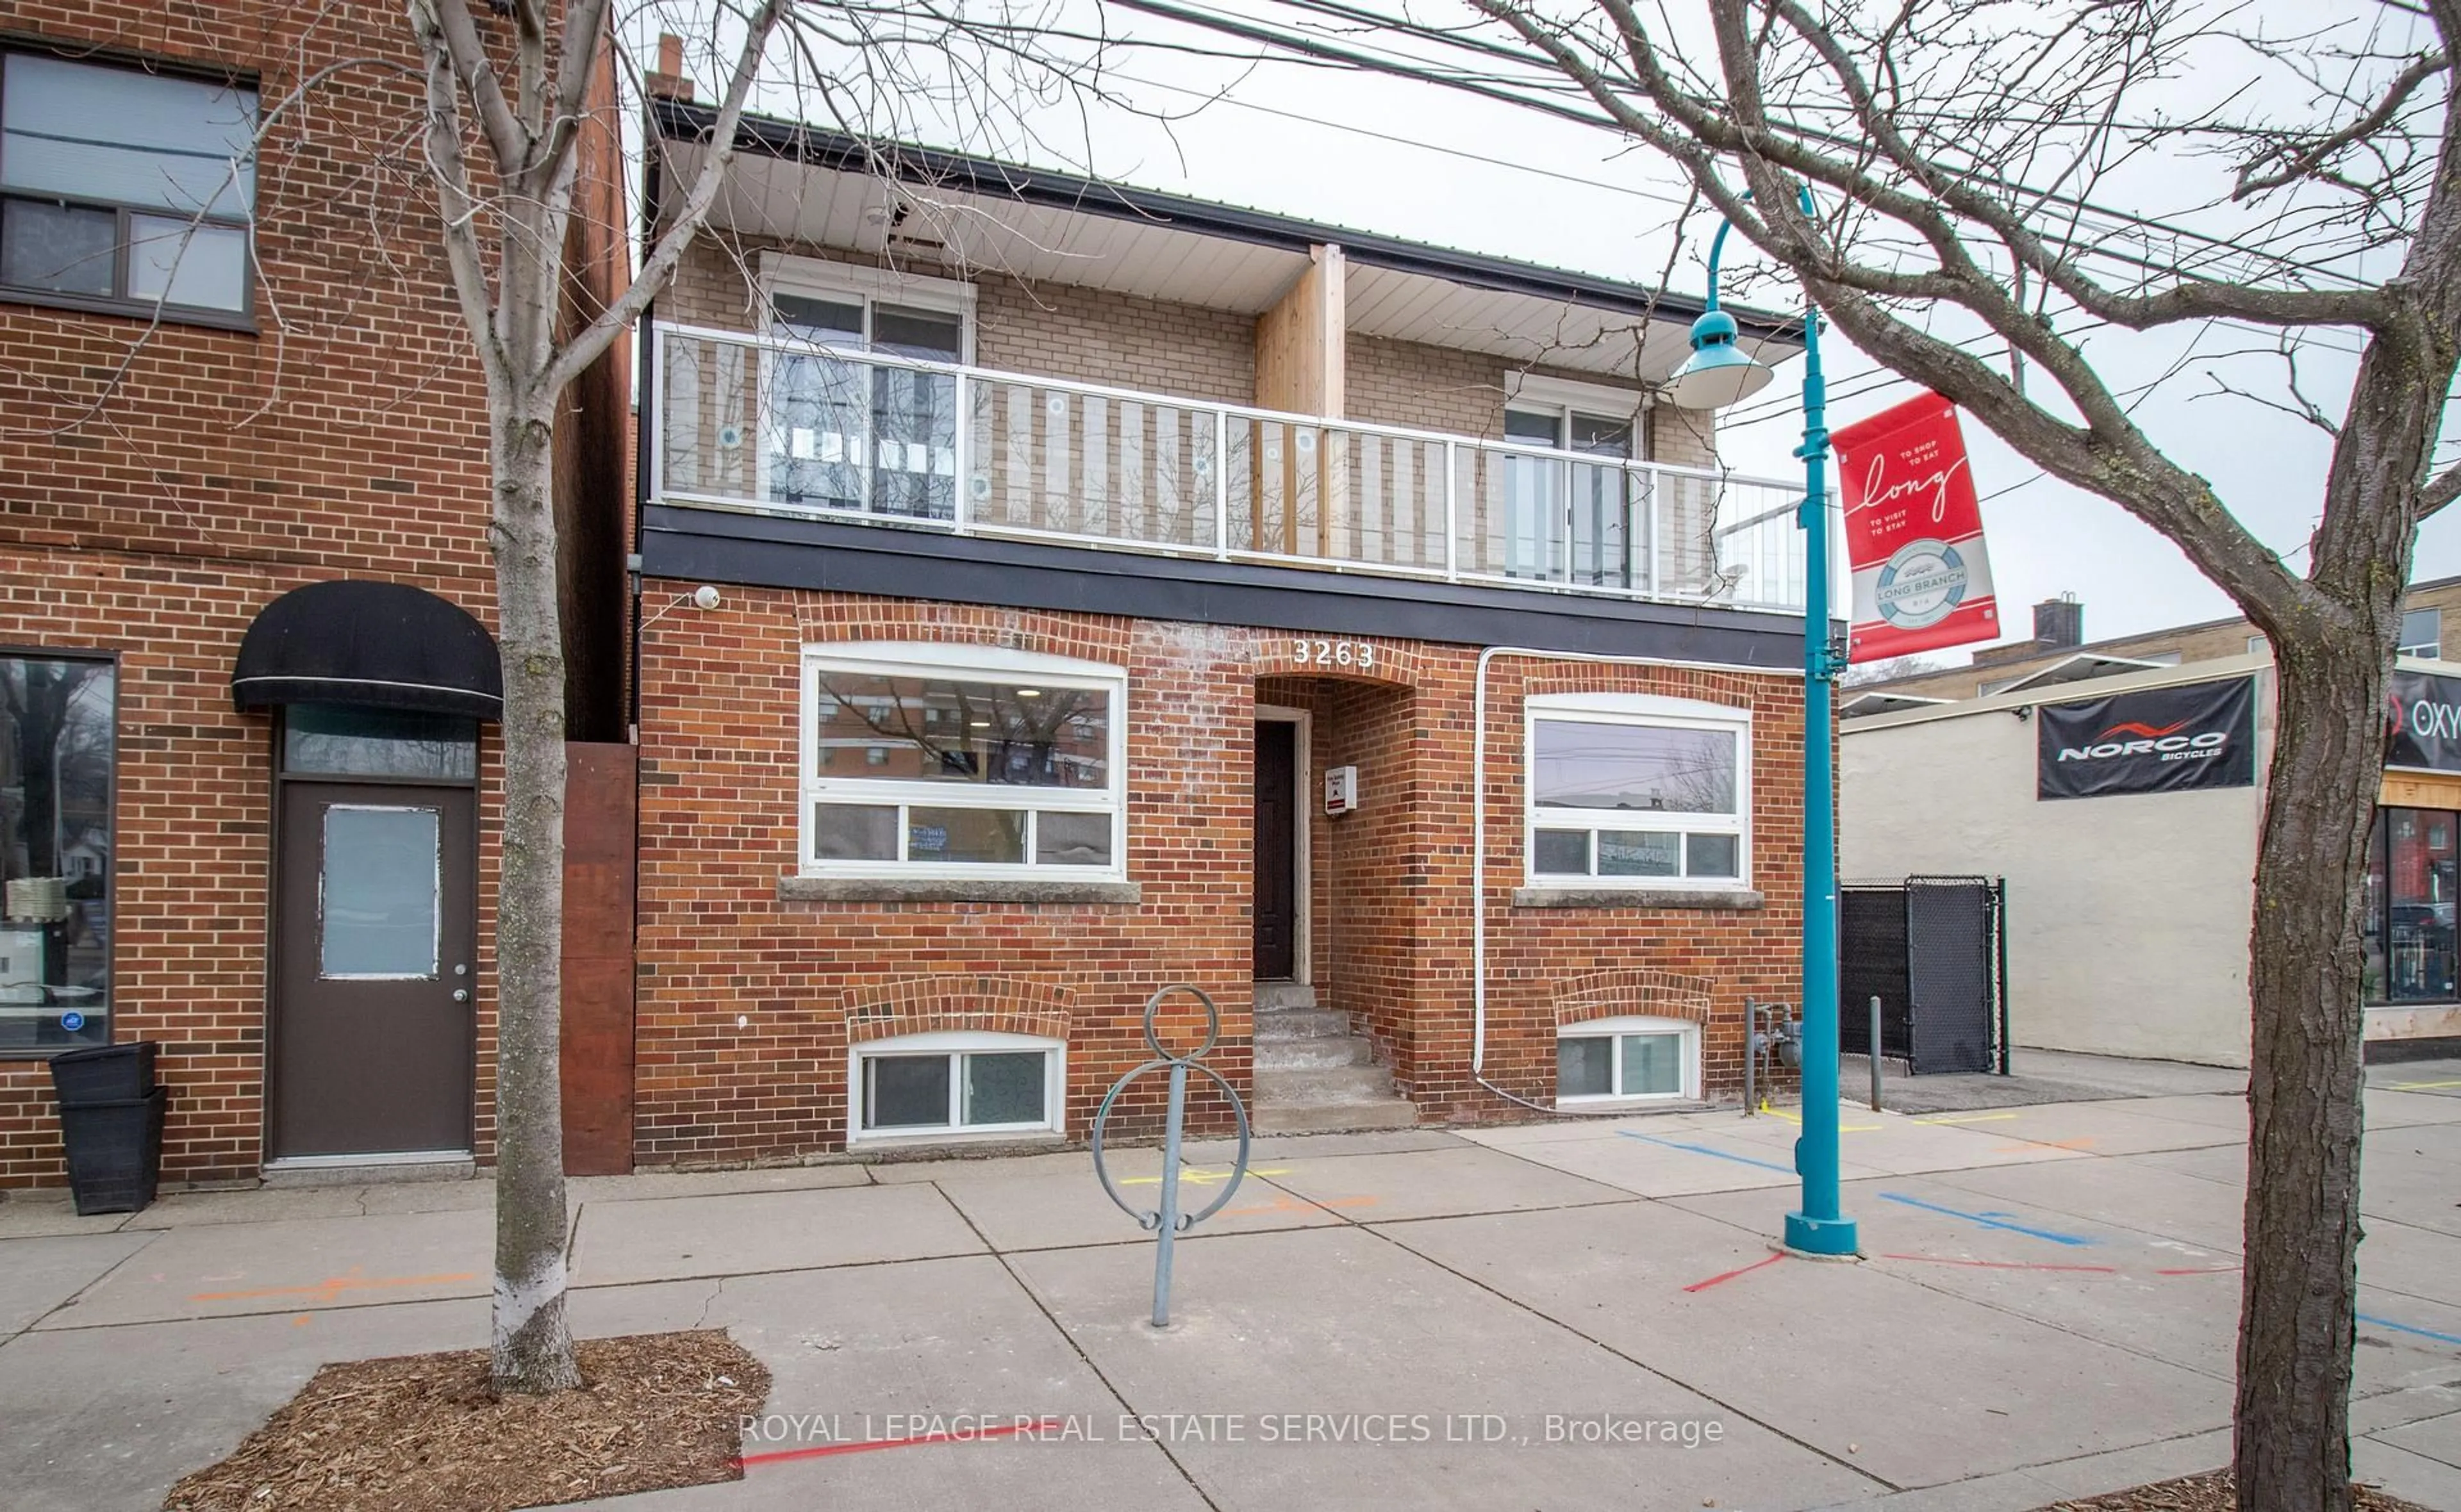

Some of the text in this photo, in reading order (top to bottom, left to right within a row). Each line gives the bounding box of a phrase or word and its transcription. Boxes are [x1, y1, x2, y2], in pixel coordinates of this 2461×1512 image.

[1900, 440, 1936, 459] TO SHOP
[1909, 450, 1939, 466] TO EAT
[1844, 454, 1968, 523] long
[1871, 520, 1906, 536] TO STAY
[1884, 510, 1907, 522] VISIT
[1878, 571, 1965, 600] LONG BRANCH
[1293, 639, 1373, 668] 3263
[2412, 700, 2461, 739] OXY
[2057, 732, 2226, 762] NORCO
[2160, 748, 2222, 761] BICYCLES
